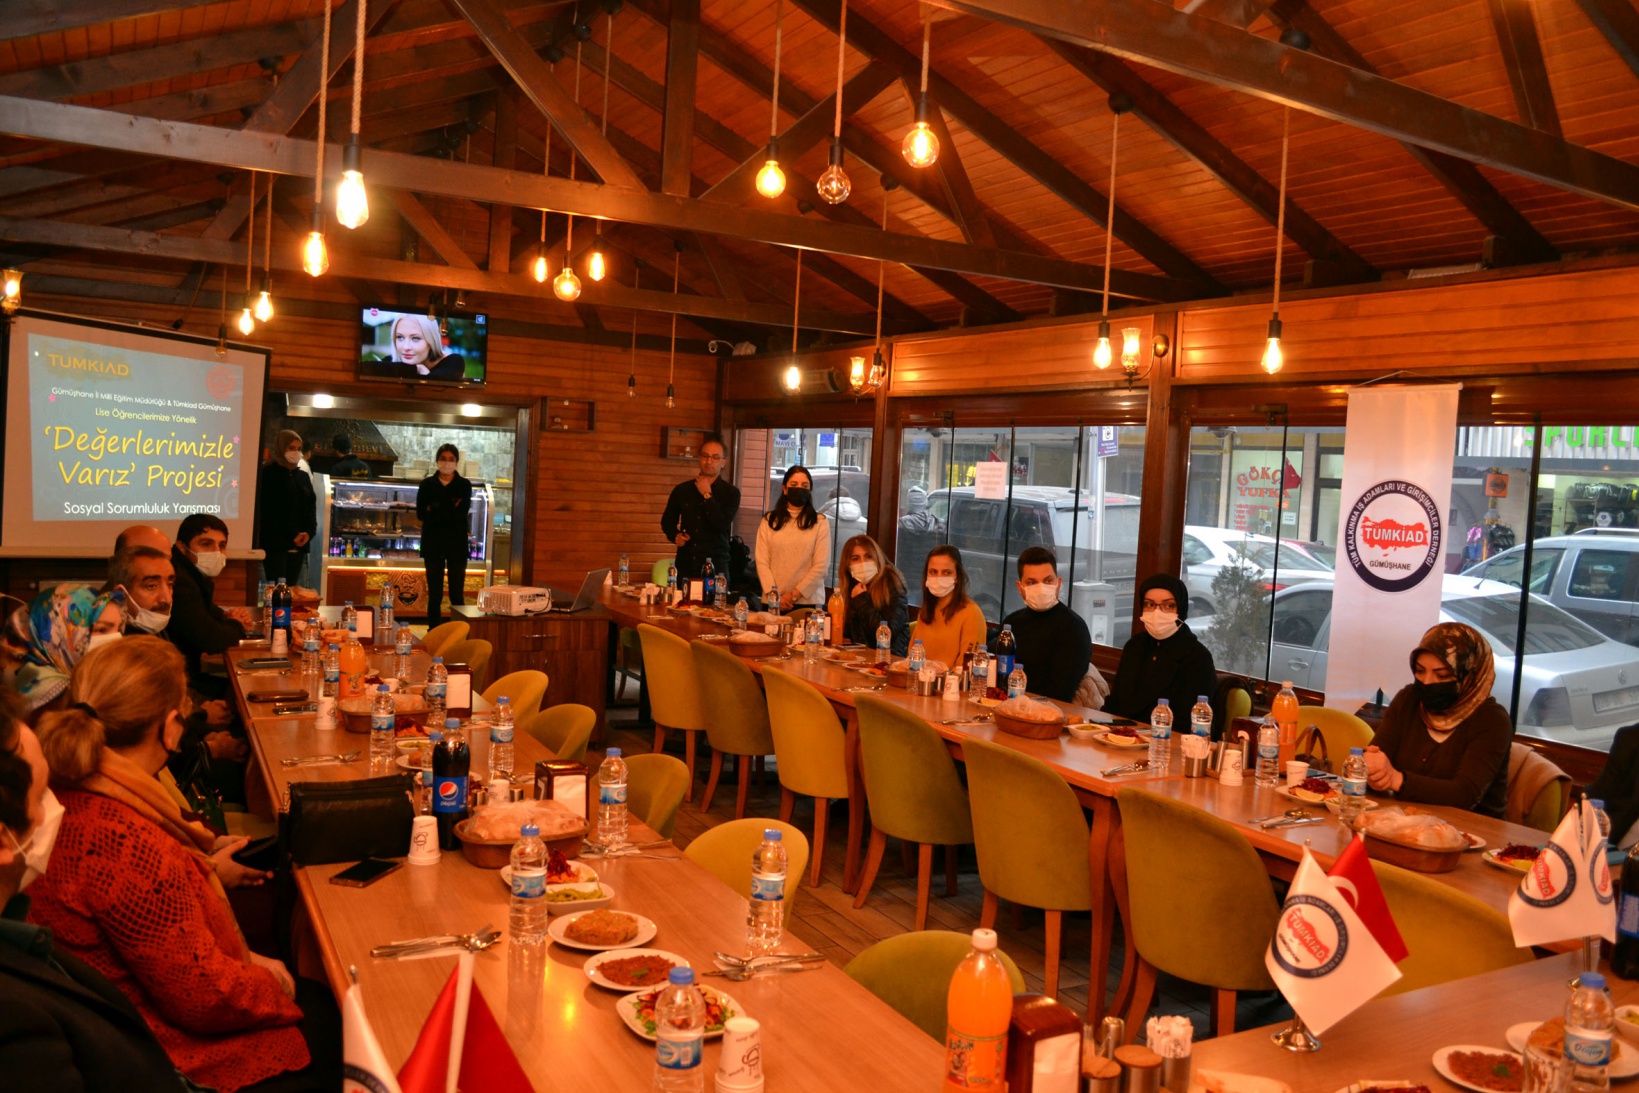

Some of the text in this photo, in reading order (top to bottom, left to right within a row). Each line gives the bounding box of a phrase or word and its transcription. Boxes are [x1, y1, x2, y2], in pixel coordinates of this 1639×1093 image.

[52, 387, 94, 400] Gümüşhane
[100, 393, 113, 401] Milli
[113, 394, 133, 404] Eğitim
[134, 396, 166, 407] Müdürlüğü
[173, 400, 198, 410] Tümkiad
[198, 402, 231, 413] Gümüşhane
[95, 408, 197, 425] Lise Öğrencilerimize Yönelik
[147, 464, 224, 495] Projesi
[64, 502, 221, 516] Sosyal Sorumluluk Yarışması
[1347, 482, 1439, 568] TÜM KALKINMA İŞ ADAMLARI VE GİRİŞİMCİLER DERNEĞİ
[1365, 526, 1424, 543] TÜMKİAD
[1369, 559, 1412, 571] GÜMÜŞHANE
